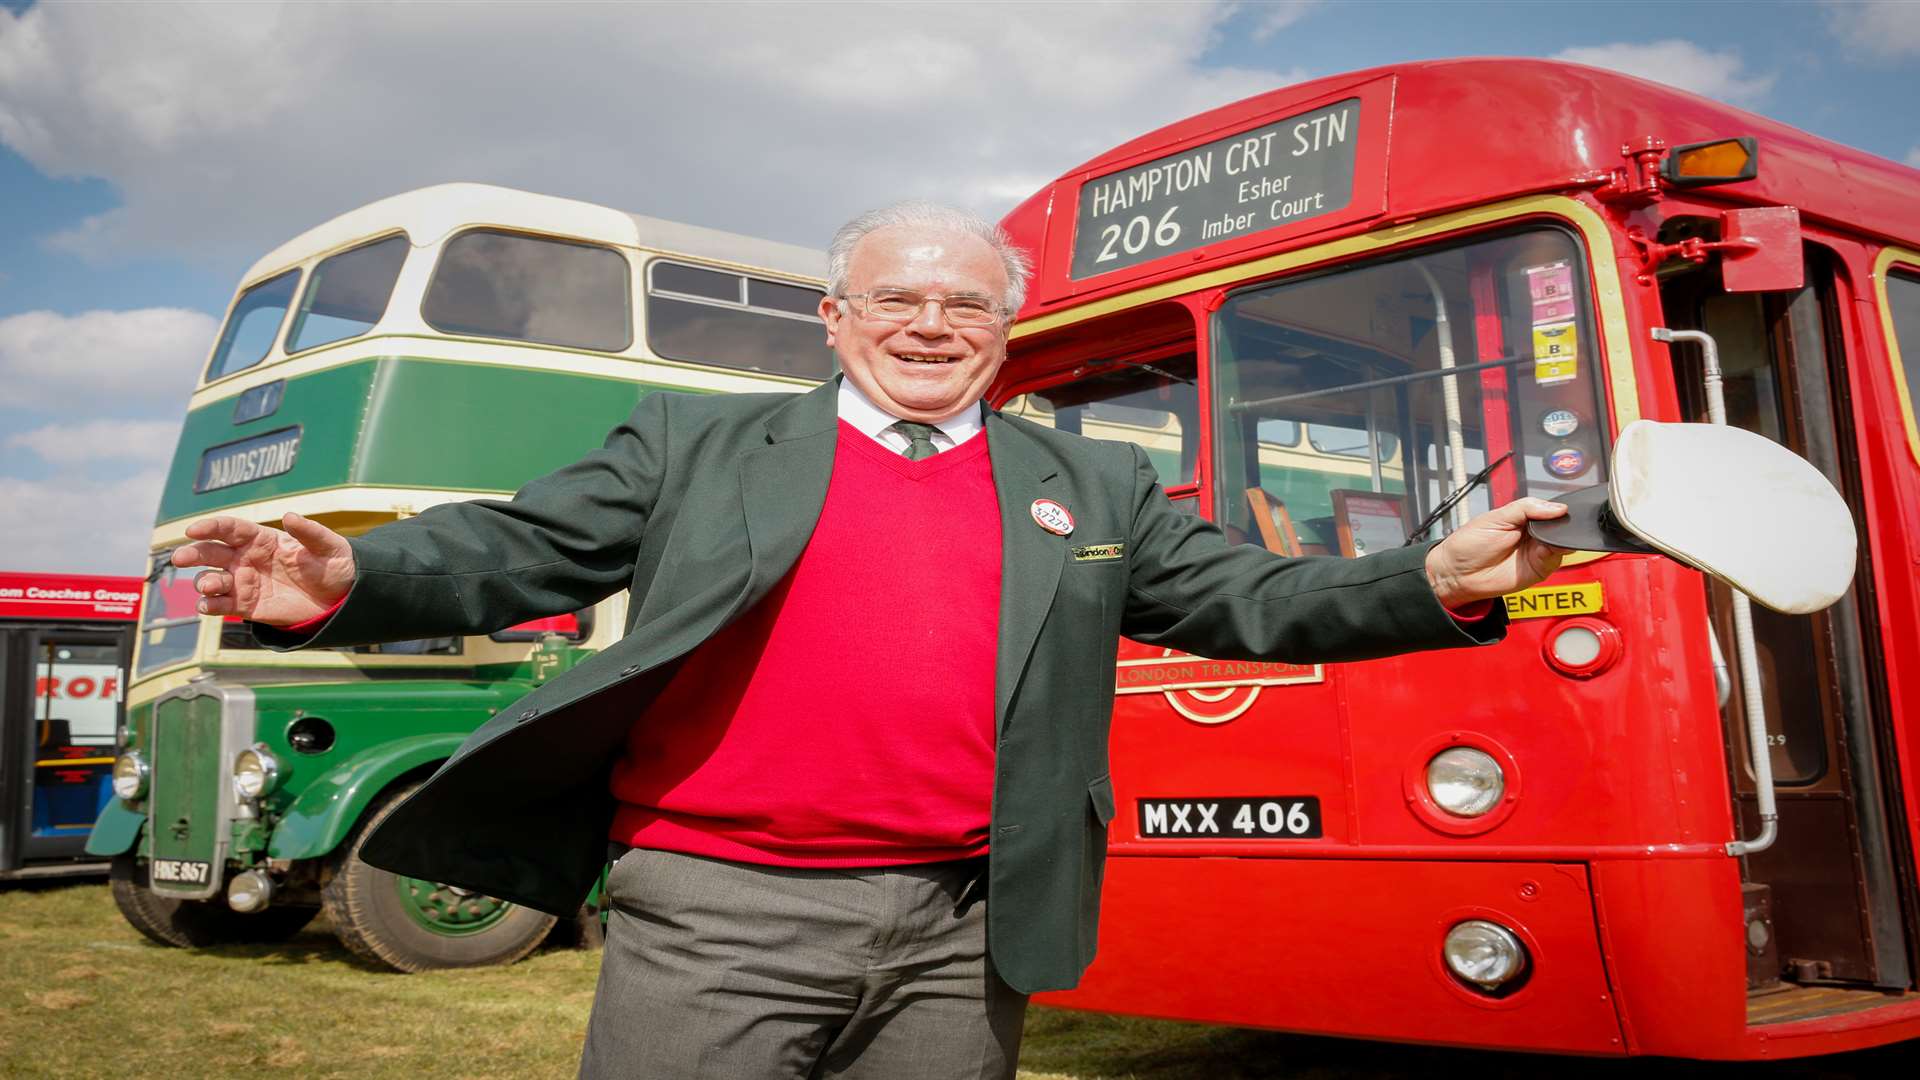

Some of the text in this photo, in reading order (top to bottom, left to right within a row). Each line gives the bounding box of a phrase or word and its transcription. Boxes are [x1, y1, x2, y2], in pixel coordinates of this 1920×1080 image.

[1093, 109, 1349, 217] HAMPTON CRT STN
[1238, 175, 1292, 204] Esher
[1202, 192, 1325, 240] Imber Court
[1095, 205, 1181, 264] 206
[1549, 344, 1560, 354] B
[205, 438, 299, 490] MAIDSTONE
[1051, 507, 1060, 516] N
[26, 587, 140, 605] Coaches Group
[1506, 591, 1588, 613] ENTER
[1119, 665, 1194, 683] LONDON
[1144, 802, 1310, 834] MXX 406
